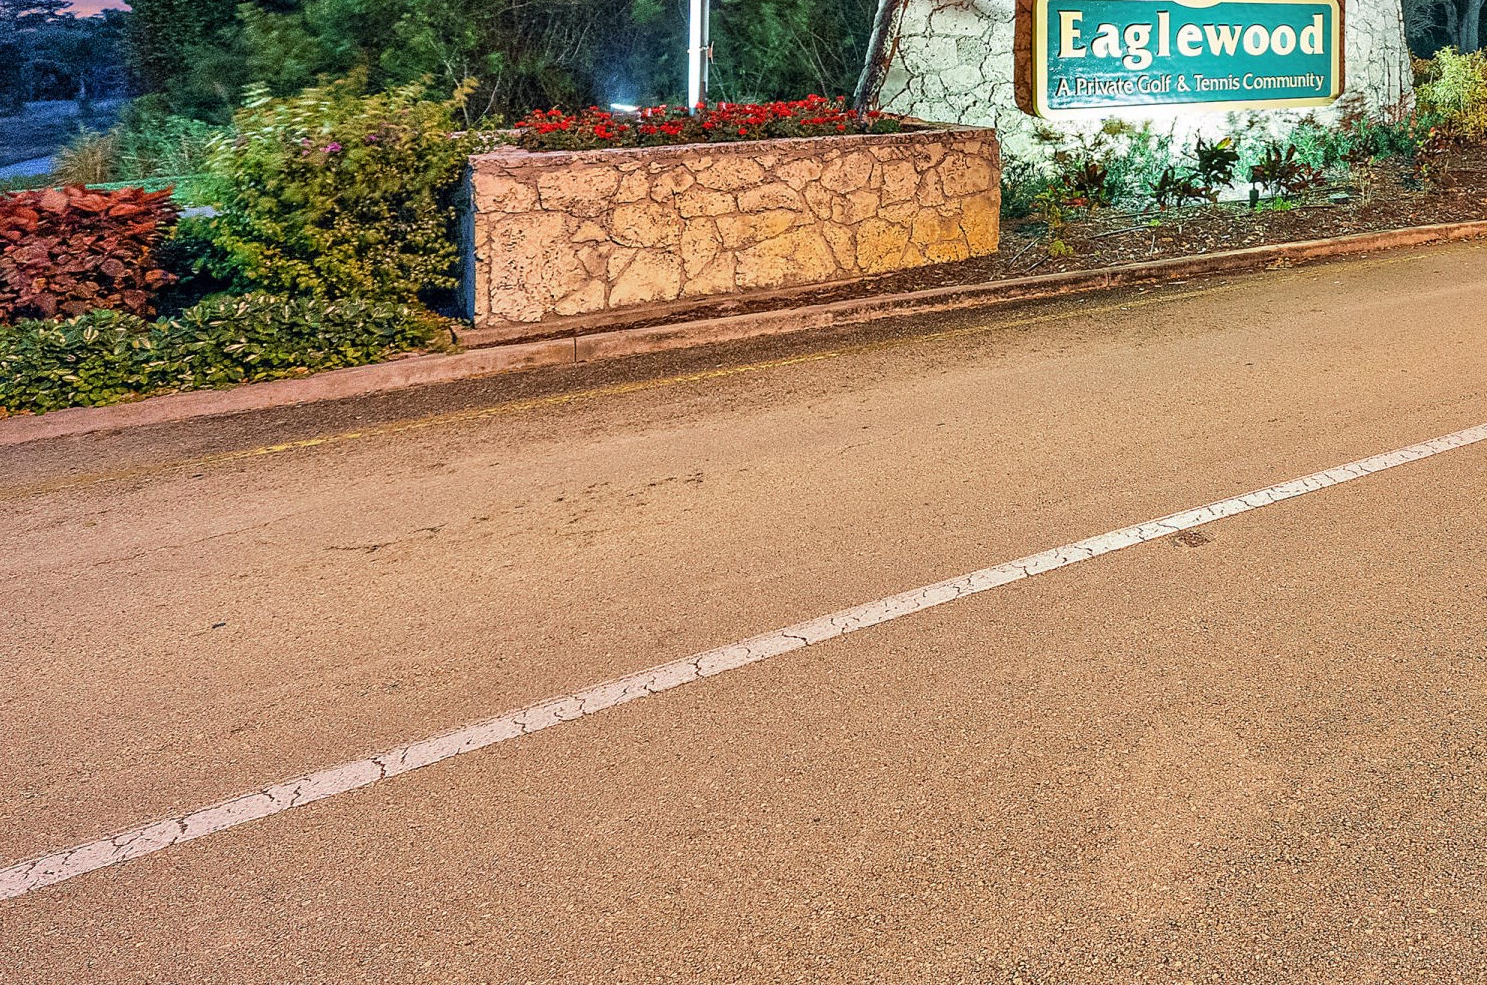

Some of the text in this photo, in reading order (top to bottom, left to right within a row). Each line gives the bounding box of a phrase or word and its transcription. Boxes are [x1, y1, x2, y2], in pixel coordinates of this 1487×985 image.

[1058, 10, 1324, 71] Eaglewood
[1056, 72, 1325, 96] A Private Golf & Tennis Community
